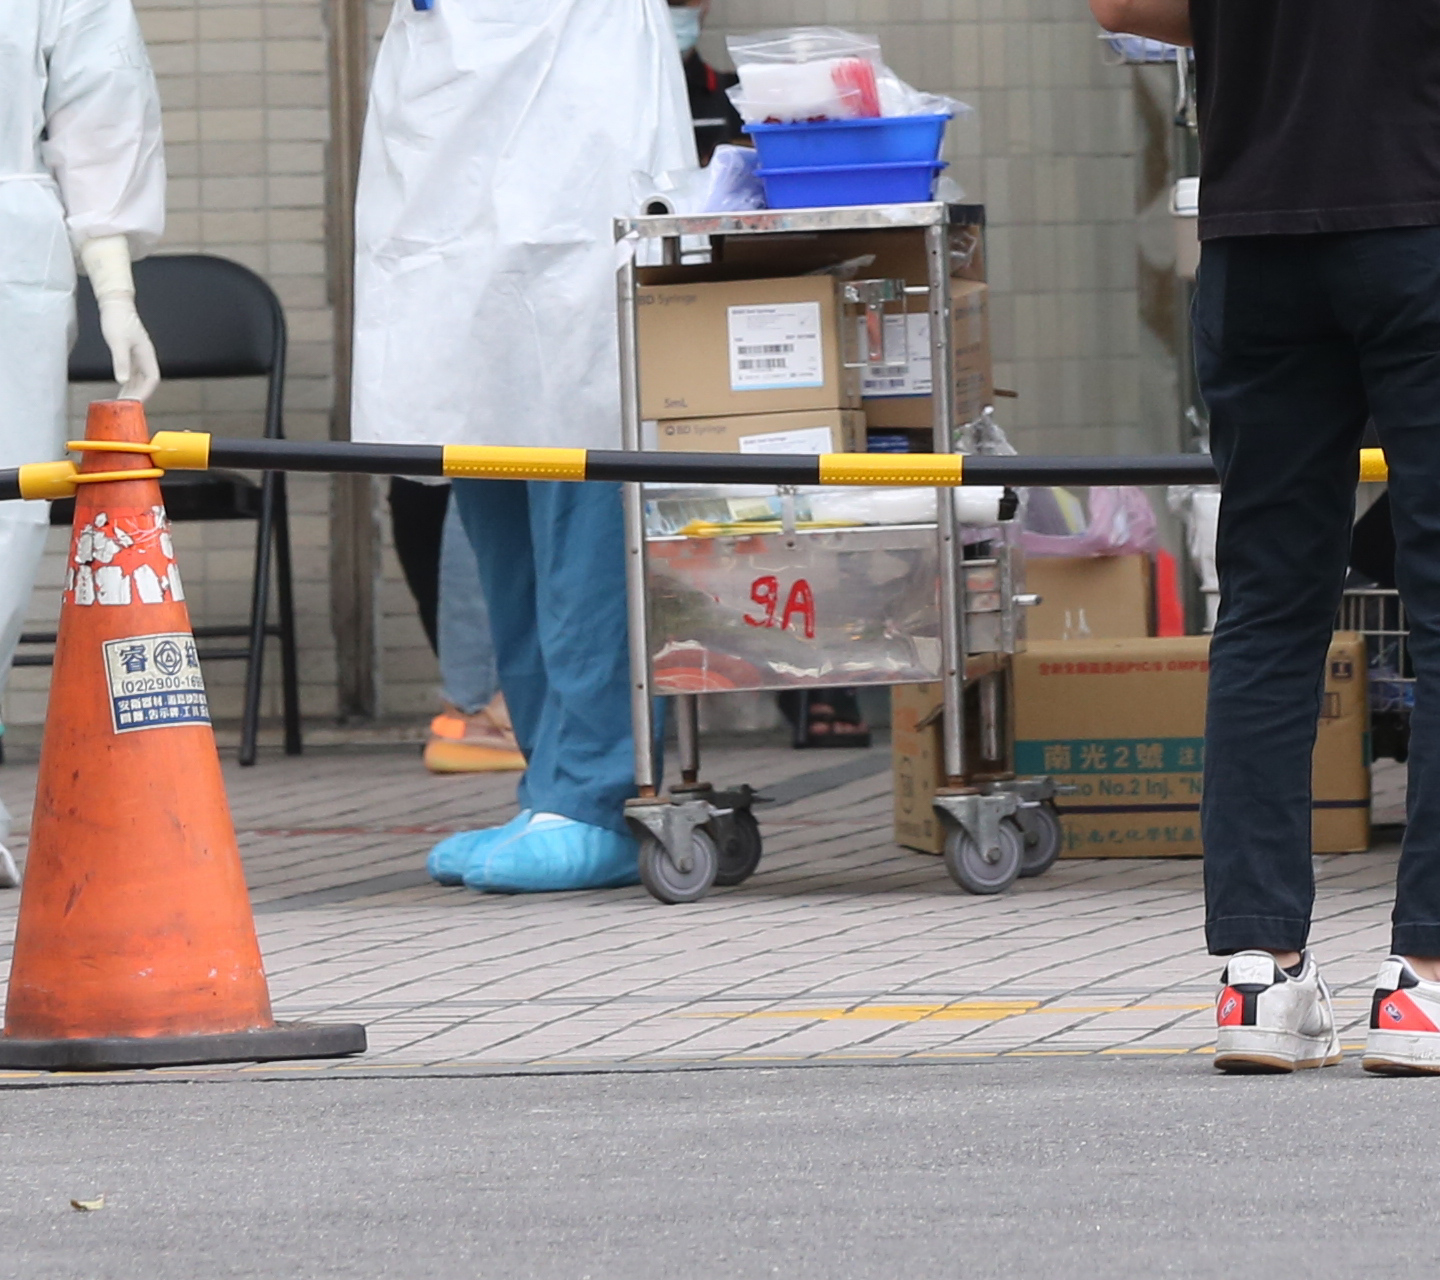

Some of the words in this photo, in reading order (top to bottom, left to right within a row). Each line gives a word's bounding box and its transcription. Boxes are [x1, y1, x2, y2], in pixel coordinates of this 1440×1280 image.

[657, 292, 697, 307] Syringe
[676, 425, 691, 435] BD
[693, 424, 727, 436] Syringe
[742, 574, 816, 639] 9A
[120, 644, 148, 674] 睿
[1098, 778, 1141, 796] No.2
